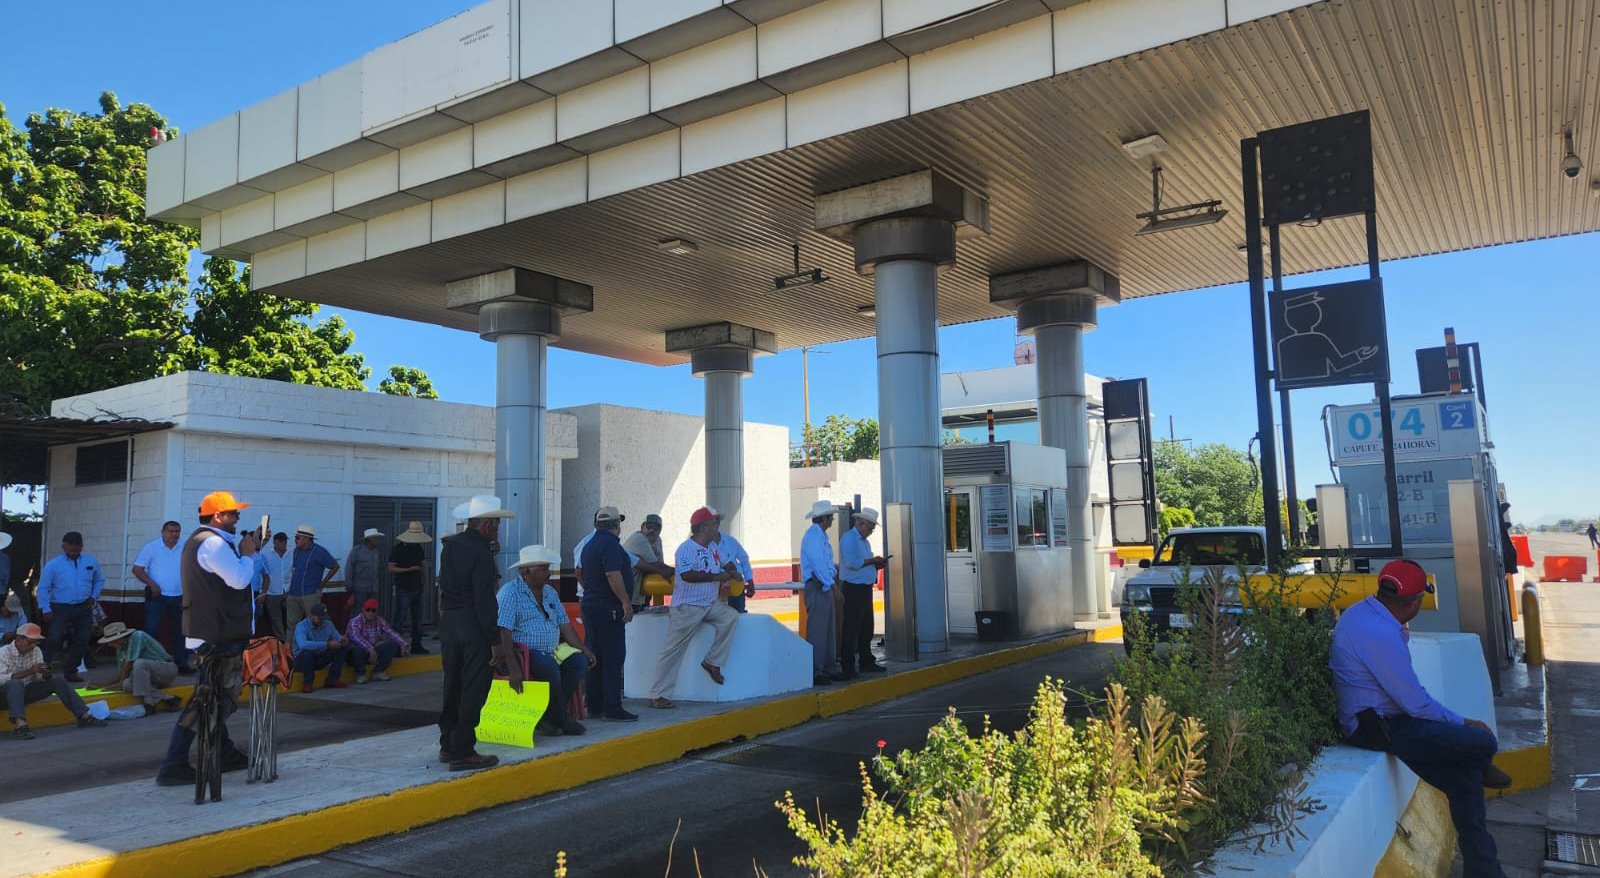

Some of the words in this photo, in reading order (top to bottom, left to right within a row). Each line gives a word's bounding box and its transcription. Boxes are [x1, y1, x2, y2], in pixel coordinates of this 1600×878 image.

[1451, 412, 1464, 427] 2
[1403, 439, 1436, 449] HORAS
[1386, 470, 1434, 484] arril
